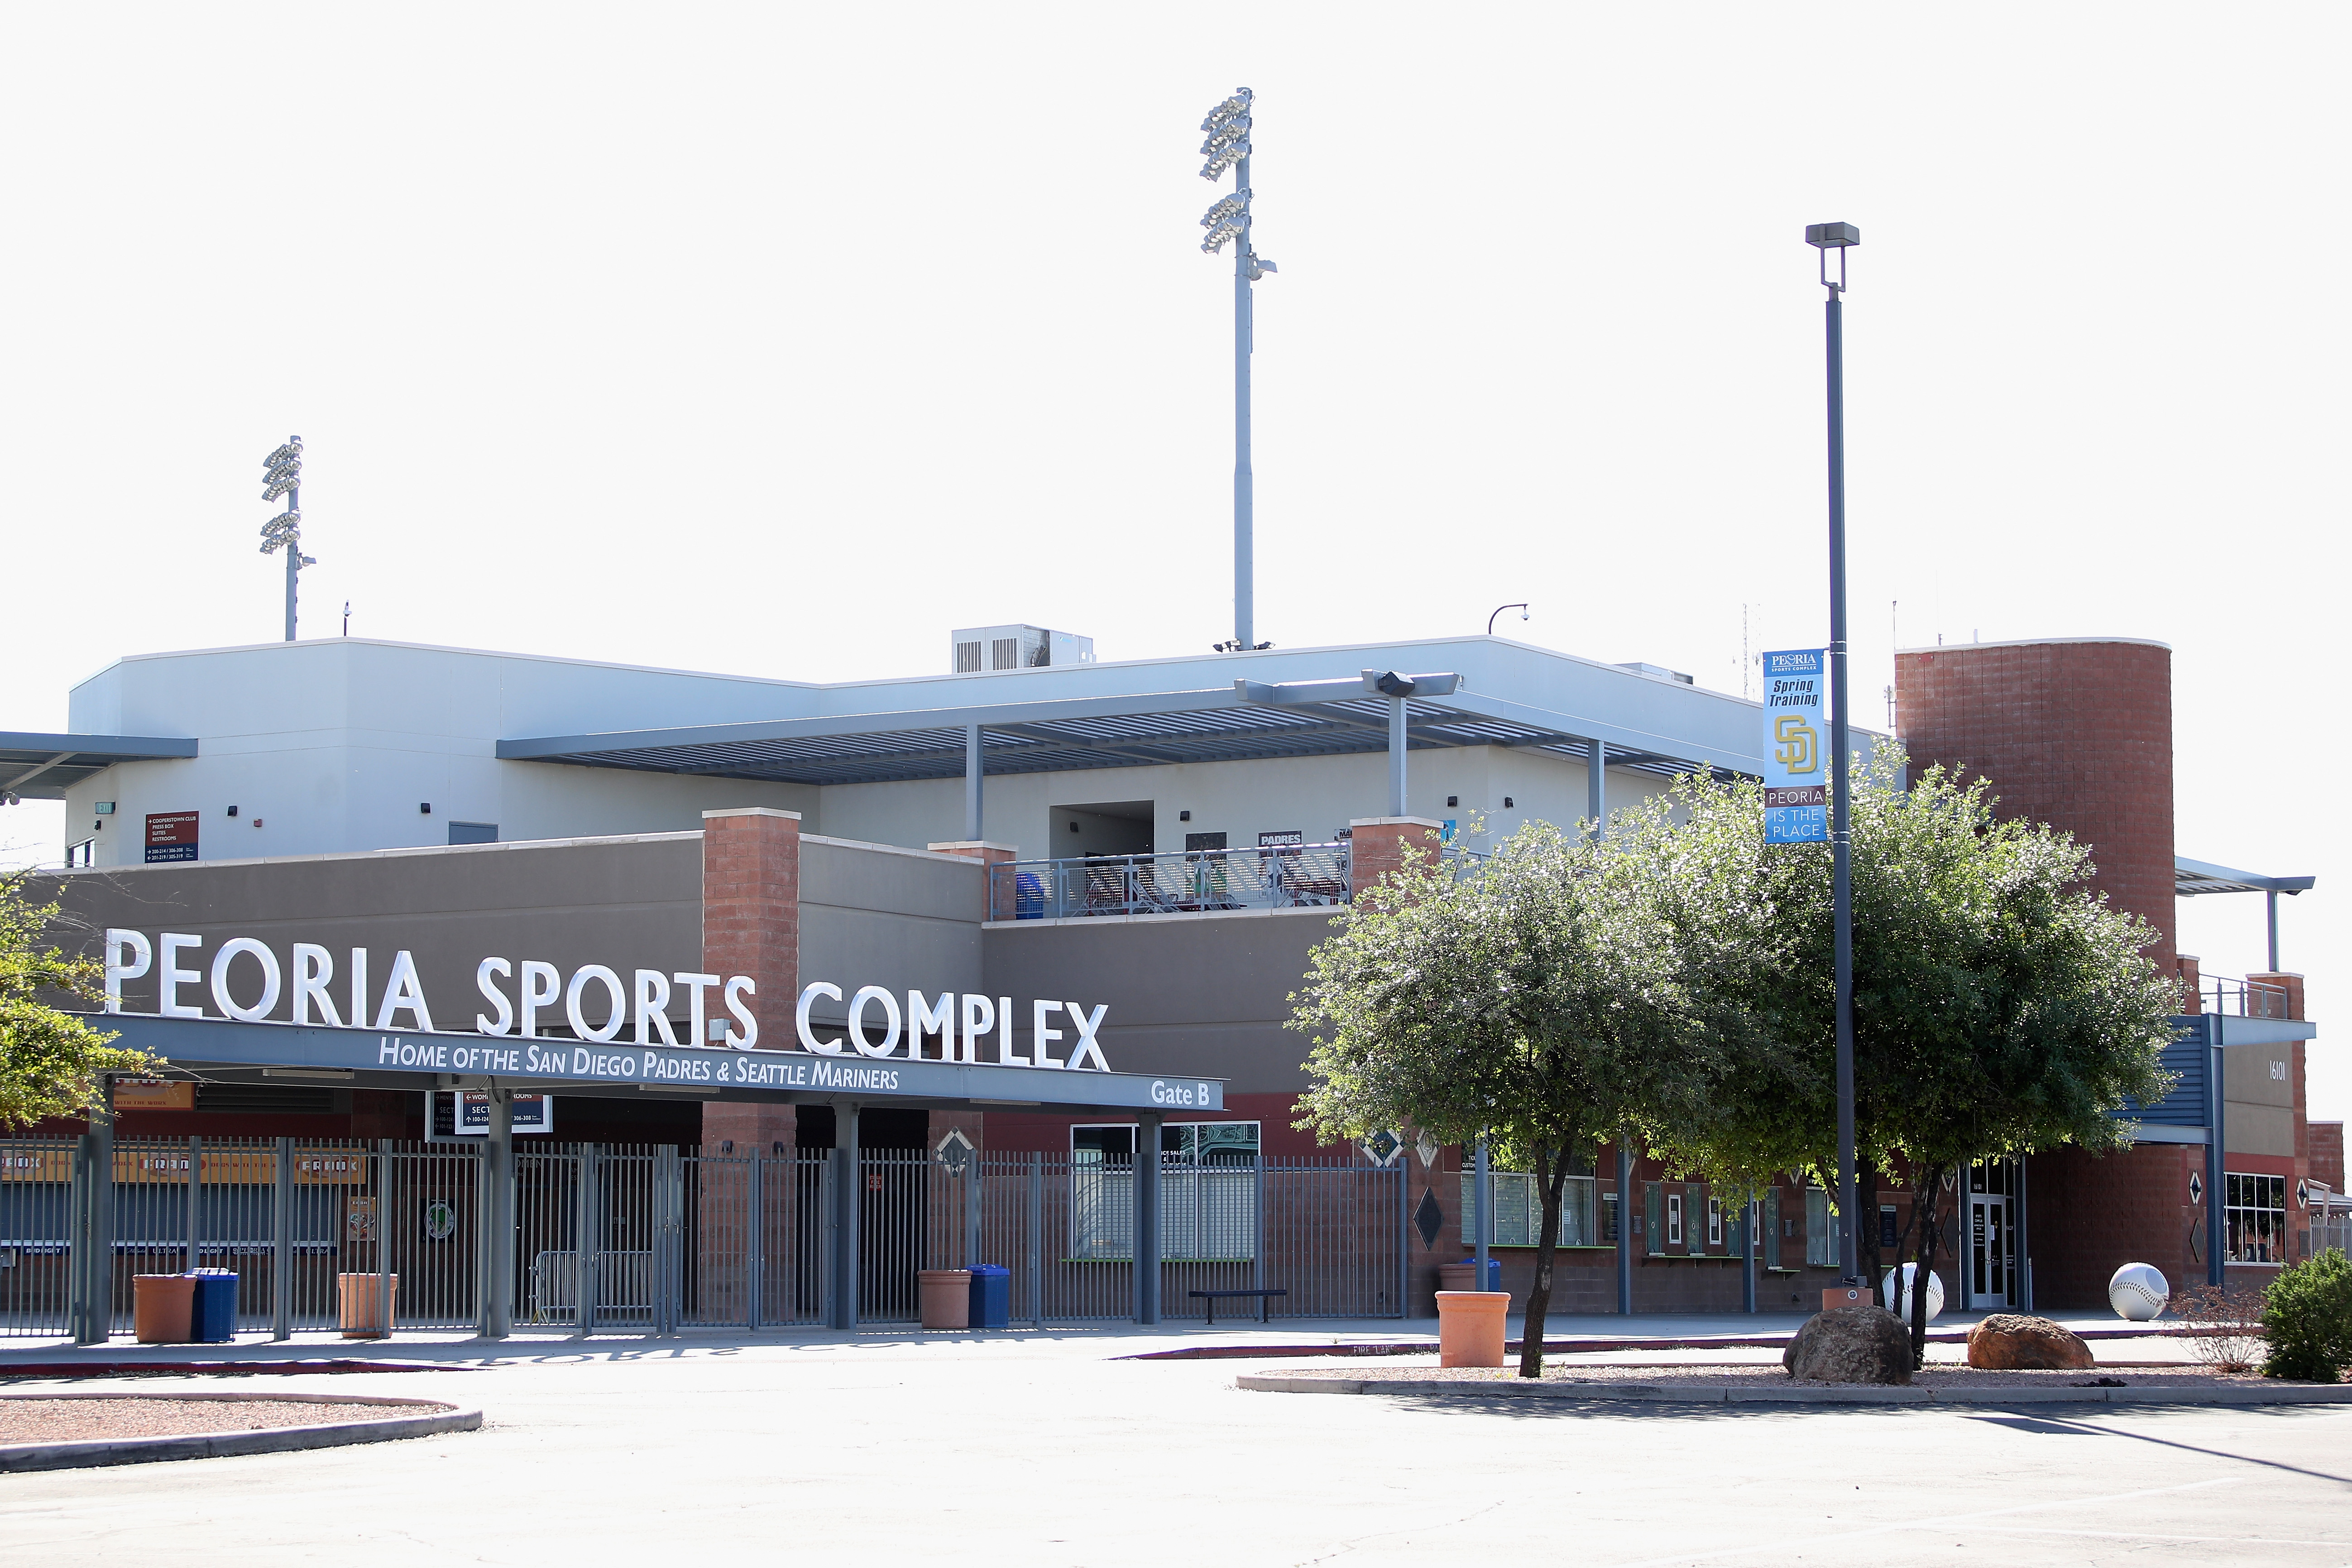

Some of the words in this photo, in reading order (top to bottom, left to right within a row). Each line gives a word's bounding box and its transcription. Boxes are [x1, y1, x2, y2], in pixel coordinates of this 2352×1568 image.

[1772, 654, 1816, 665] PEORIA
[1773, 679, 1814, 694] Spring
[1769, 693, 1818, 706] Training
[1774, 715, 1817, 773] SD
[1769, 791, 1823, 804] PEORIA
[99, 803, 111, 813] EXIT
[1773, 810, 1785, 822] IS
[1791, 809, 1819, 821] THE
[1773, 824, 1820, 837] PLACE
[1261, 834, 1301, 845] PADRES
[105, 928, 435, 1032] PEORIA
[477, 957, 758, 1050] SPORTS
[795, 982, 1111, 1072] COMPLEX
[378, 1036, 447, 1068] HOME
[453, 1047, 479, 1069] OF
[481, 1049, 519, 1071] THE
[526, 1045, 566, 1073] SAN
[572, 1047, 636, 1077] DIEGO
[643, 1051, 711, 1081] PADRES
[716, 1062, 729, 1082] &
[736, 1056, 806, 1085] SEATTLE
[810, 1061, 899, 1089] MARINERS
[2270, 1060, 2285, 1081] 16101
[1151, 1080, 1192, 1105] Gate
[1198, 1083, 1210, 1106] B
[1353, 1346, 1370, 1355] FIRE
